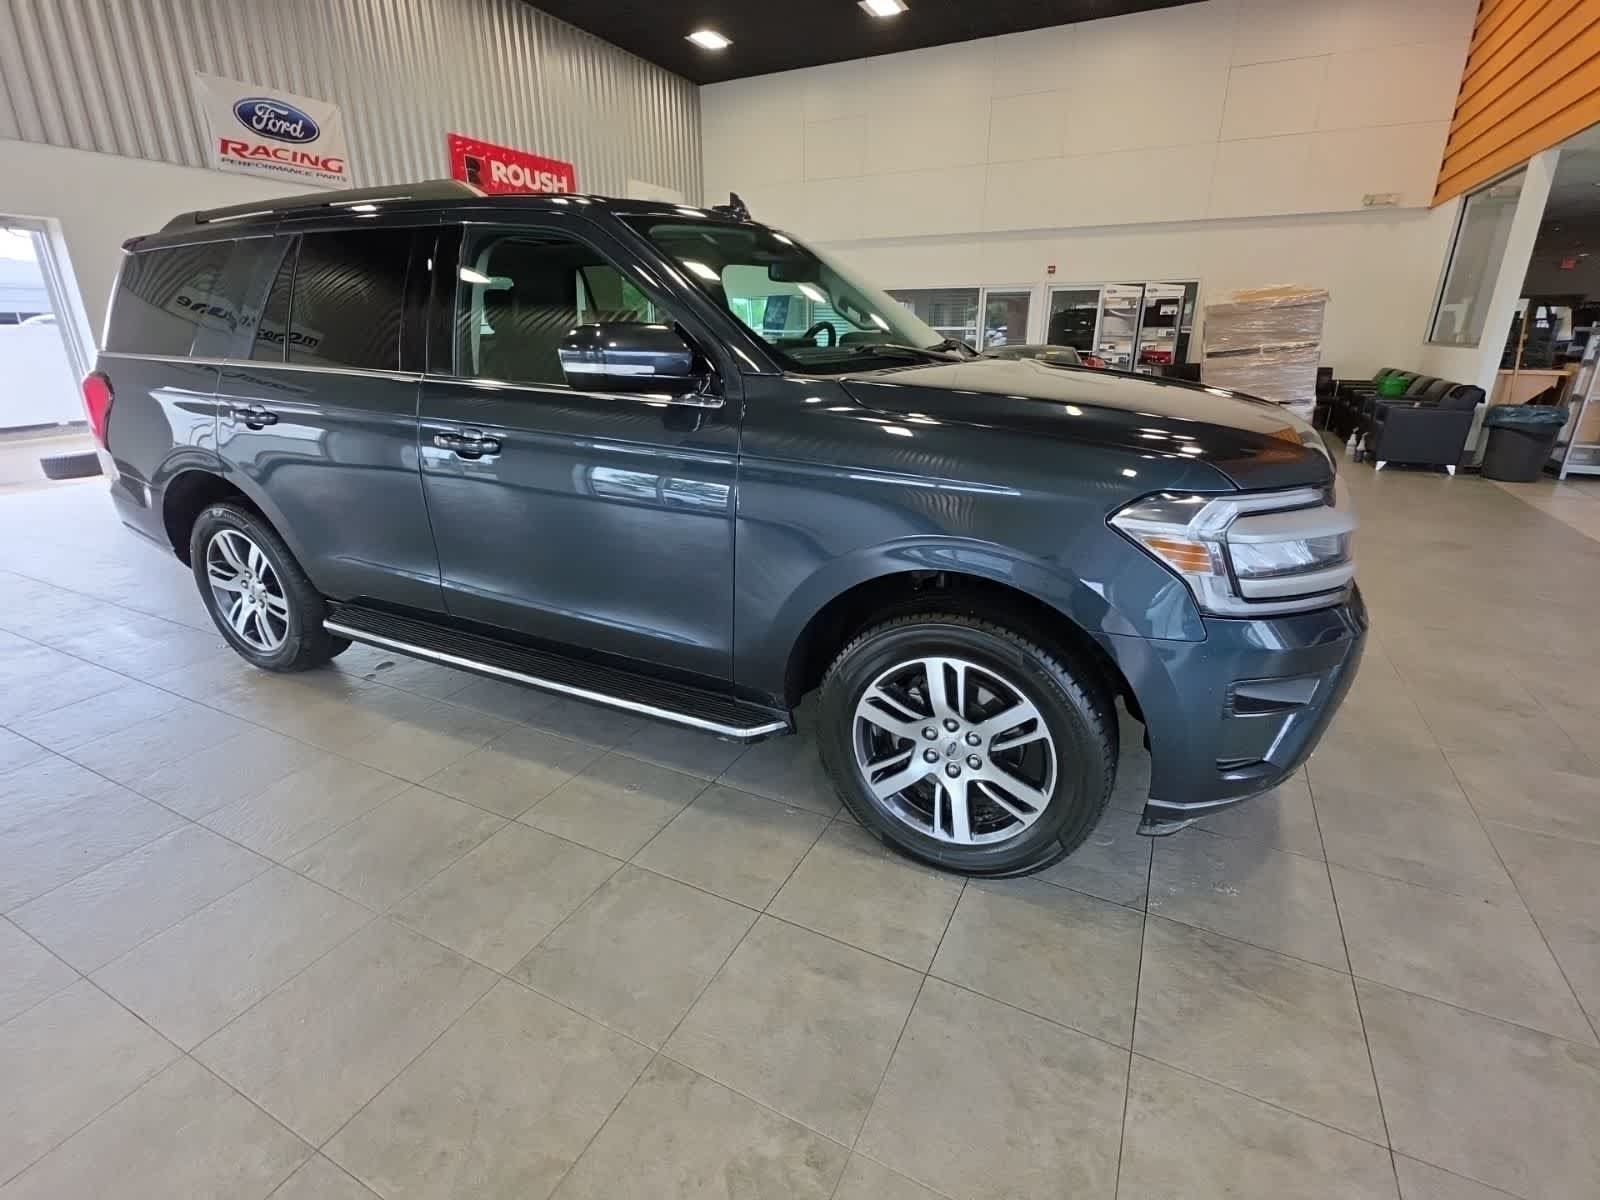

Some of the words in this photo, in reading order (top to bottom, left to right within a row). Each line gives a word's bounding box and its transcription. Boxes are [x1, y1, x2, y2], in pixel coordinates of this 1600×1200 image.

[252, 103, 305, 138] Ford
[219, 138, 344, 173] RACING
[220, 157, 313, 177] PERFORMANCE
[315, 172, 348, 182] PARTS
[491, 160, 568, 193] ROUSH
